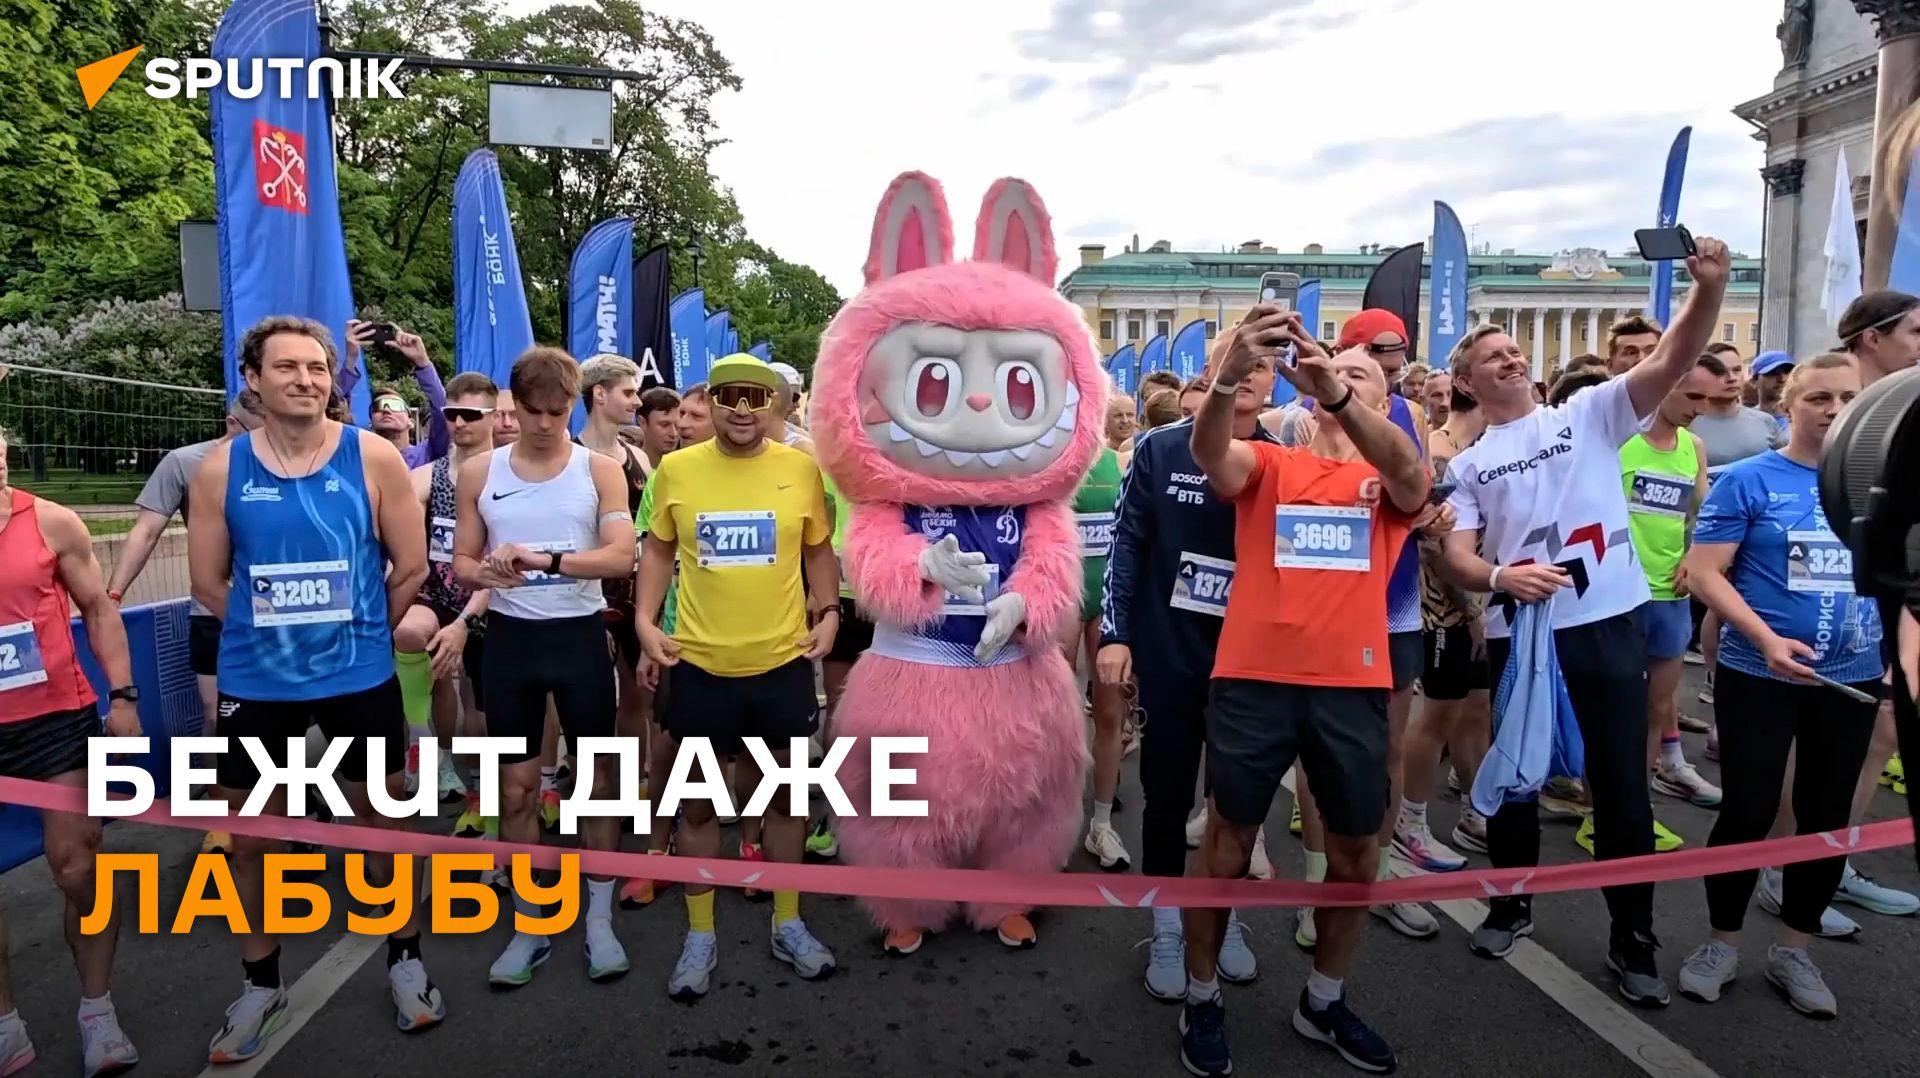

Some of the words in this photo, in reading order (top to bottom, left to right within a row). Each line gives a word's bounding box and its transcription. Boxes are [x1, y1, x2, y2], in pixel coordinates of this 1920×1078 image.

[1477, 443, 1573, 486] Северсаль
[1170, 473, 1203, 485] BOSCO
[1177, 489, 1204, 504] ВТБ
[1643, 482, 1682, 506] 3528
[715, 526, 758, 550] 2771
[1293, 522, 1352, 551] 3696
[271, 578, 331, 608] 3203
